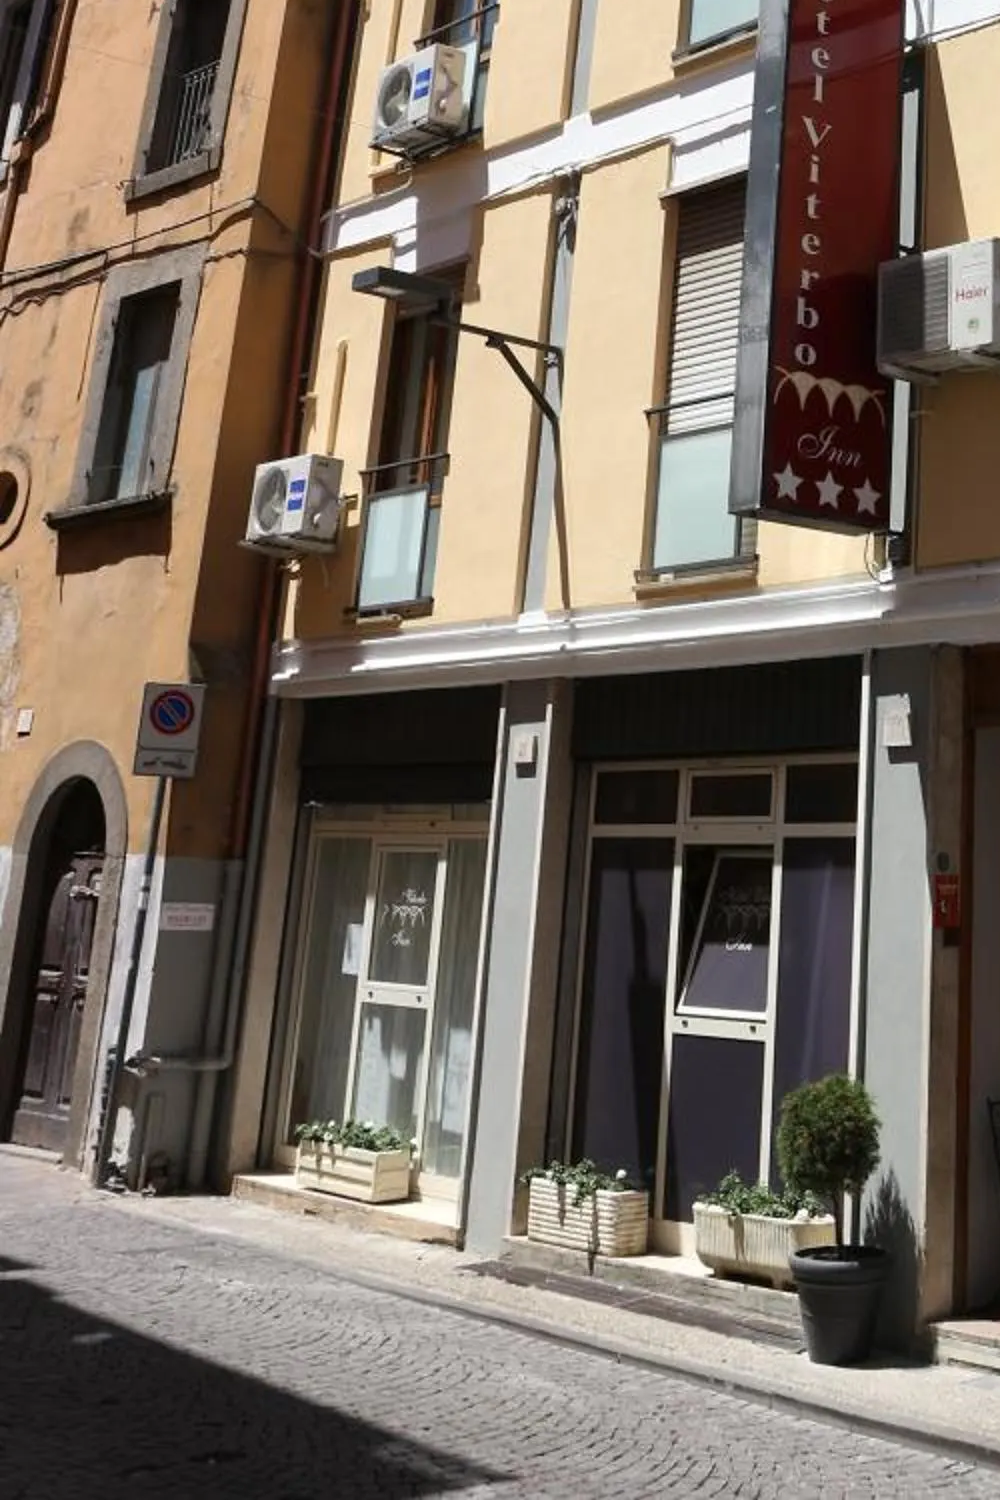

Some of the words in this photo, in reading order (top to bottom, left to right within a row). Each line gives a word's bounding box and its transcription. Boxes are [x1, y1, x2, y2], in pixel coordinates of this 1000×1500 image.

[794, 115, 833, 366] Viterbo
[955, 284, 989, 303] Haier
[796, 426, 862, 468] Inn
